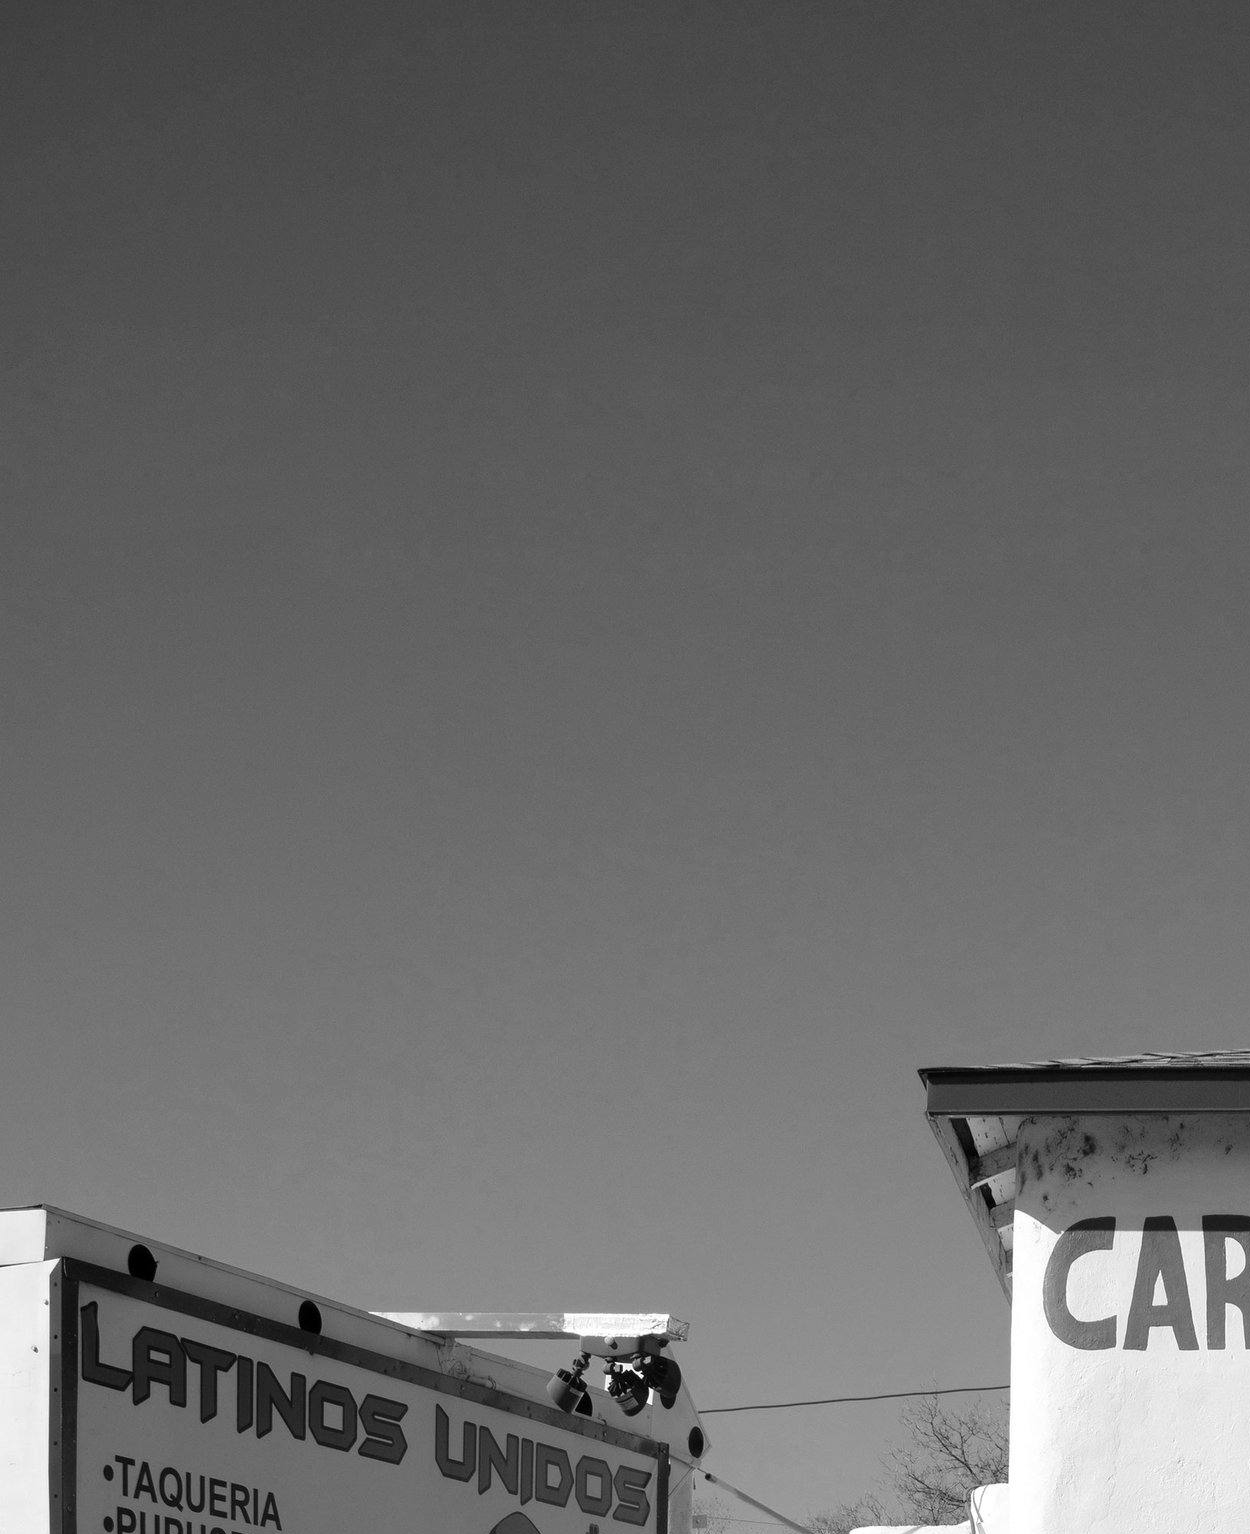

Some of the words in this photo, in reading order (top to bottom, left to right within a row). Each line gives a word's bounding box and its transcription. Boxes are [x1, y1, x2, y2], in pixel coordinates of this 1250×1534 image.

[80, 1301, 408, 1465] LATINOS
[435, 1403, 652, 1527] UNIDOS
[115, 1454, 282, 1531] TAQUERIA
